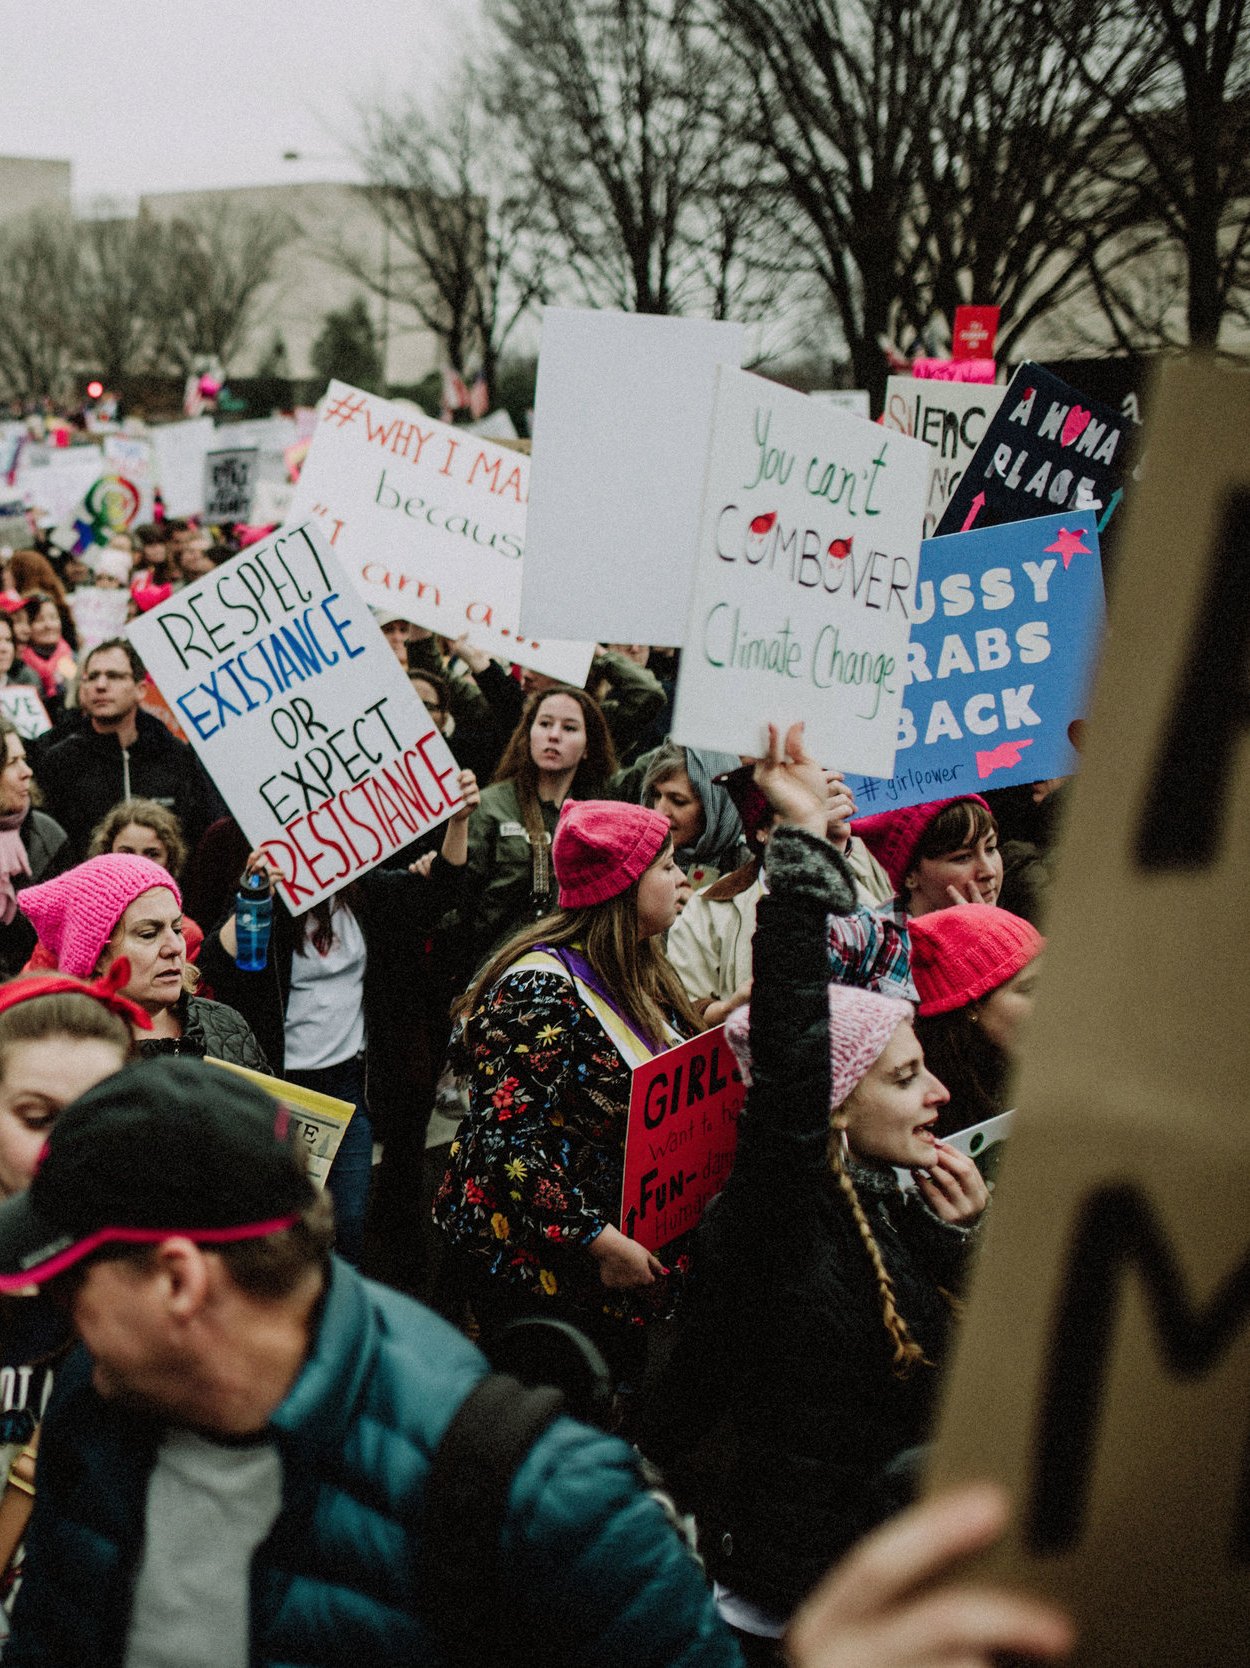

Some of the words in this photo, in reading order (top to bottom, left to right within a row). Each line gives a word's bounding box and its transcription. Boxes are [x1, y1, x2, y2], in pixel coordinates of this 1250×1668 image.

[323, 392, 435, 465] #WHY
[438, 438, 460, 477] I
[466, 451, 530, 504] MA
[743, 407, 795, 490] You
[806, 441, 888, 517] can't
[1008, 386, 1037, 427] A
[1037, 401, 1121, 466] WMA
[375, 468, 523, 560] becaus
[716, 504, 912, 620] COMBOVER
[156, 521, 332, 671] RESPECT
[362, 562, 441, 606] am
[910, 559, 1058, 625] USSY
[176, 593, 366, 741] EXISTANCE
[704, 602, 802, 680] Climate
[812, 625, 896, 720] Change
[904, 621, 1052, 686] RABS
[259, 697, 402, 826] EXPECT
[271, 697, 329, 750] OR
[896, 684, 1042, 751] BACK
[261, 730, 465, 907] RESISTANCE
[296, 1120, 320, 1145] E
